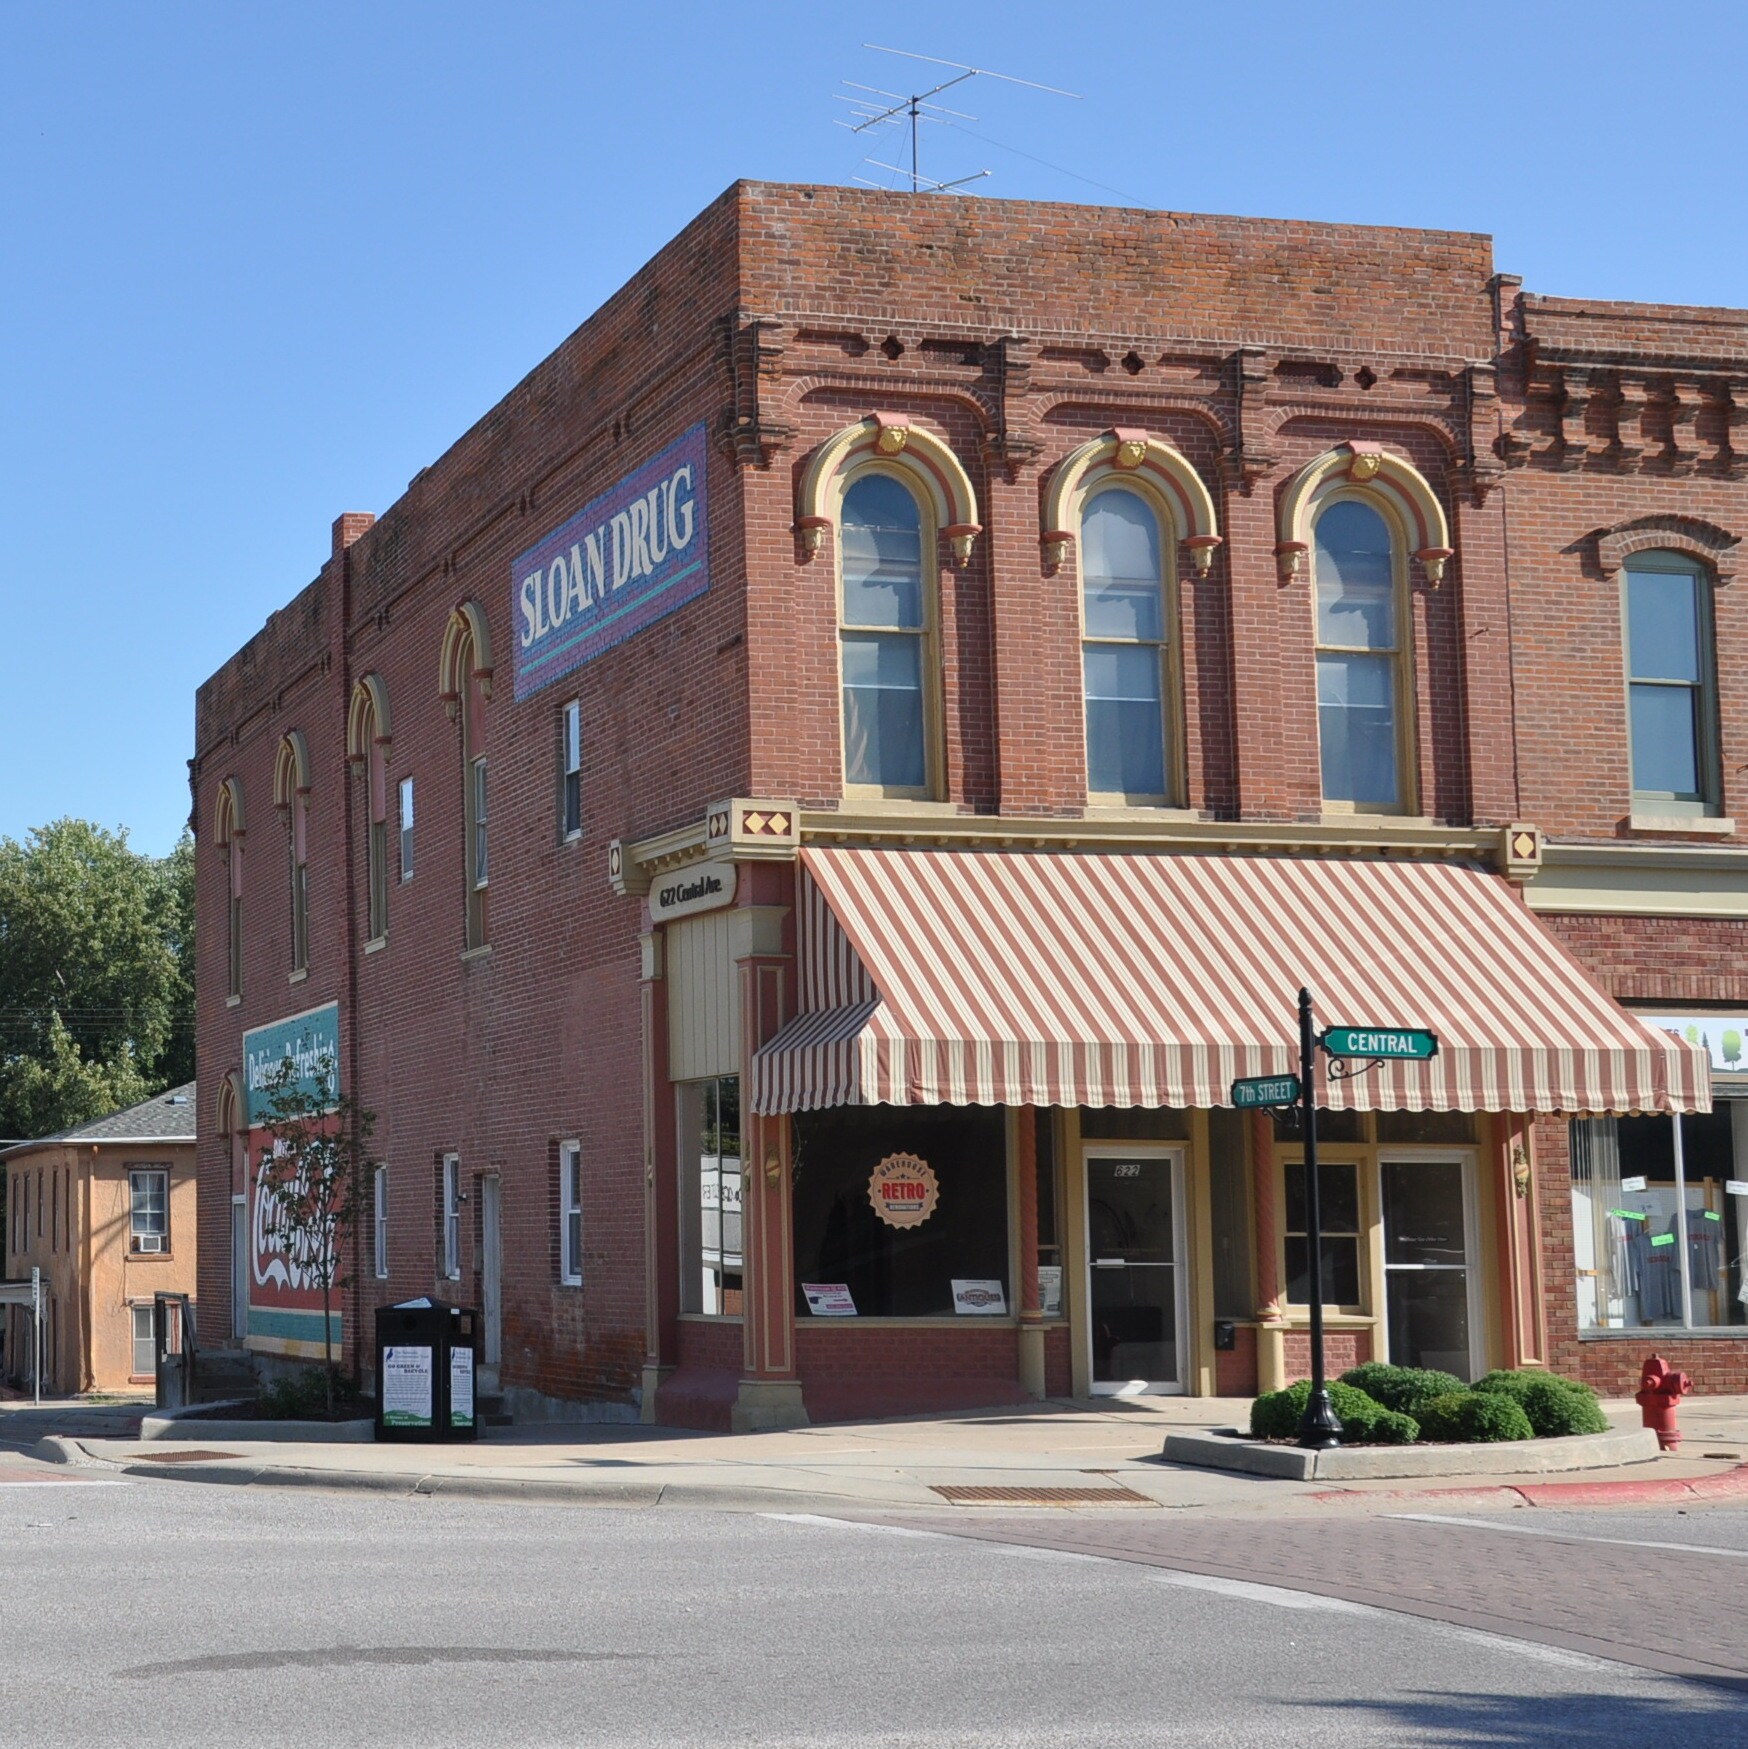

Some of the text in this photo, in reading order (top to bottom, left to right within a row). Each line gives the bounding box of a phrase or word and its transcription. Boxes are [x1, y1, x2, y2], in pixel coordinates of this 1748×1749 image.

[520, 464, 694, 648] SLOAN DRUG
[659, 886, 676, 908] 622
[676, 875, 705, 903] Central
[1347, 1032, 1418, 1053] CENTRAL
[1239, 1081, 1292, 1102] 7th STREET
[1116, 1165, 1139, 1177] 622
[882, 1182, 925, 1200] RETRO
